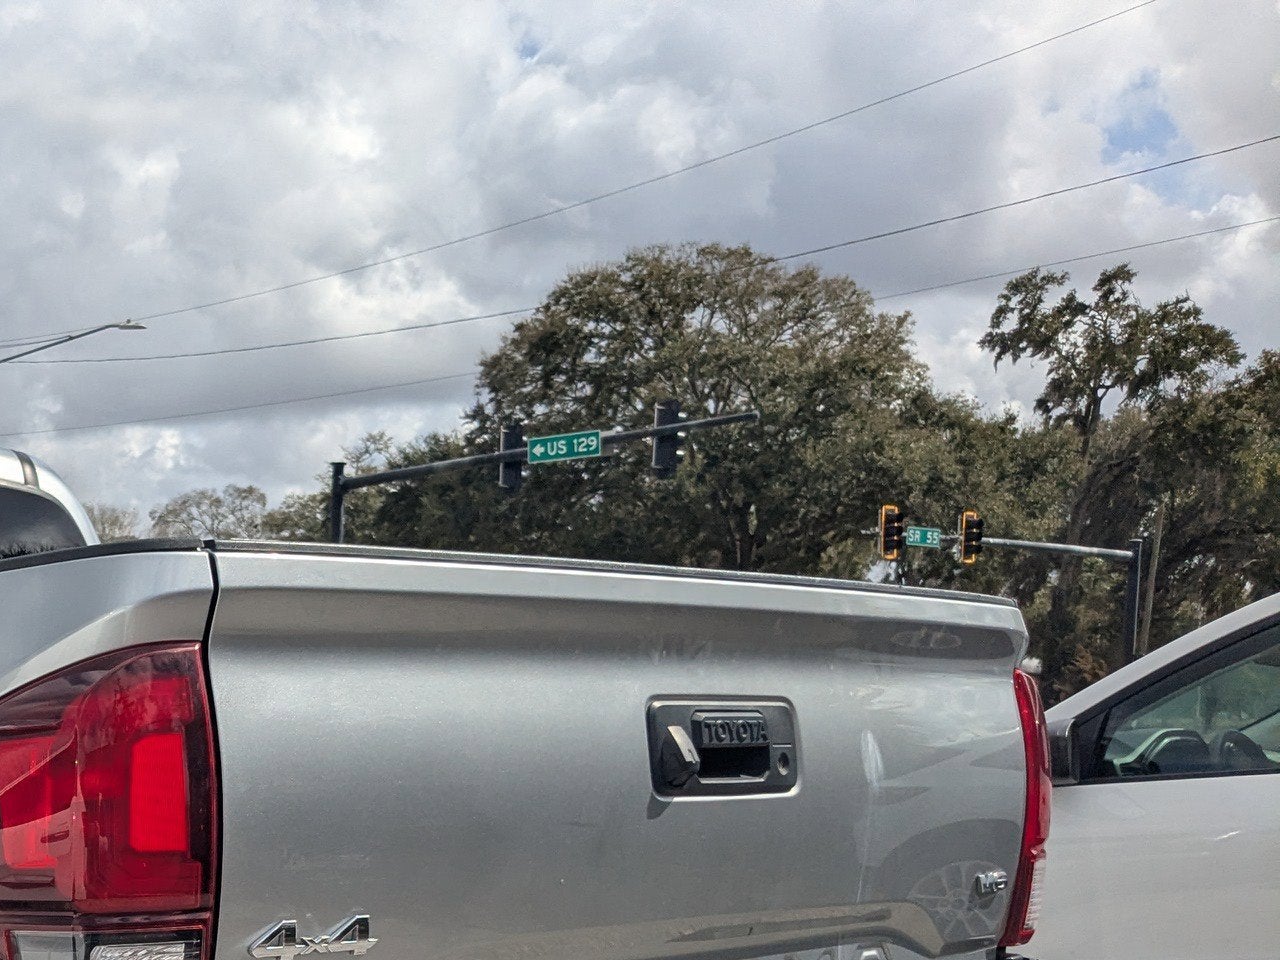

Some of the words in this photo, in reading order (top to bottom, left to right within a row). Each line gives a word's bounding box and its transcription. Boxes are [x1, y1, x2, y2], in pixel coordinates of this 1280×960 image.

[547, 440, 567, 456] US
[573, 436, 597, 453] 129
[908, 530, 920, 542] SR
[926, 532, 939, 544] 55
[703, 719, 771, 743] TOYOTA
